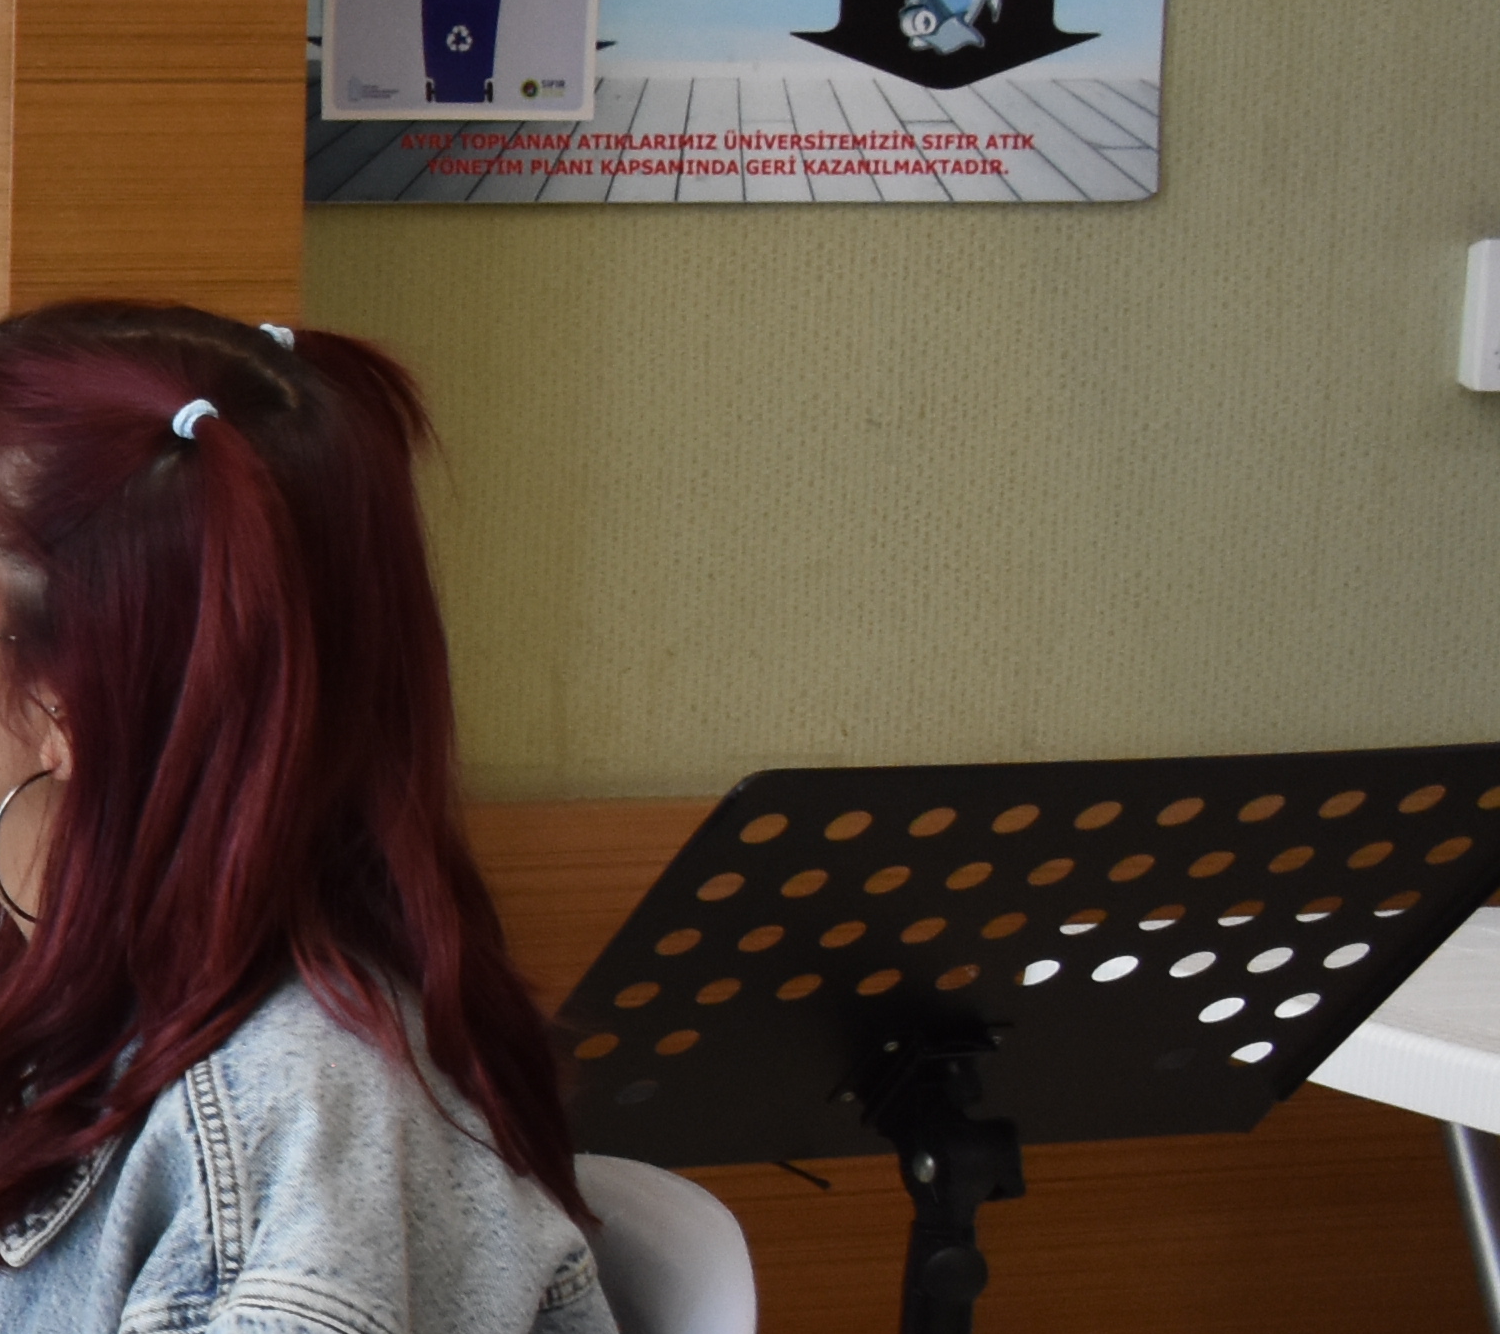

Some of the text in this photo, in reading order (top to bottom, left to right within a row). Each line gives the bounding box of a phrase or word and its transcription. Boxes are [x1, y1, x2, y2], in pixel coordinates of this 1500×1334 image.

[401, 129, 1035, 151] AYRI TOPLANAN ATIKLARIMIZ ÜNİVERSİTEMİZİN SIFIR ATIK
[426, 154, 1009, 177] YÖNETİM PLANI KAPSAMINDA GERİ KAZANILMAKTADIR.
